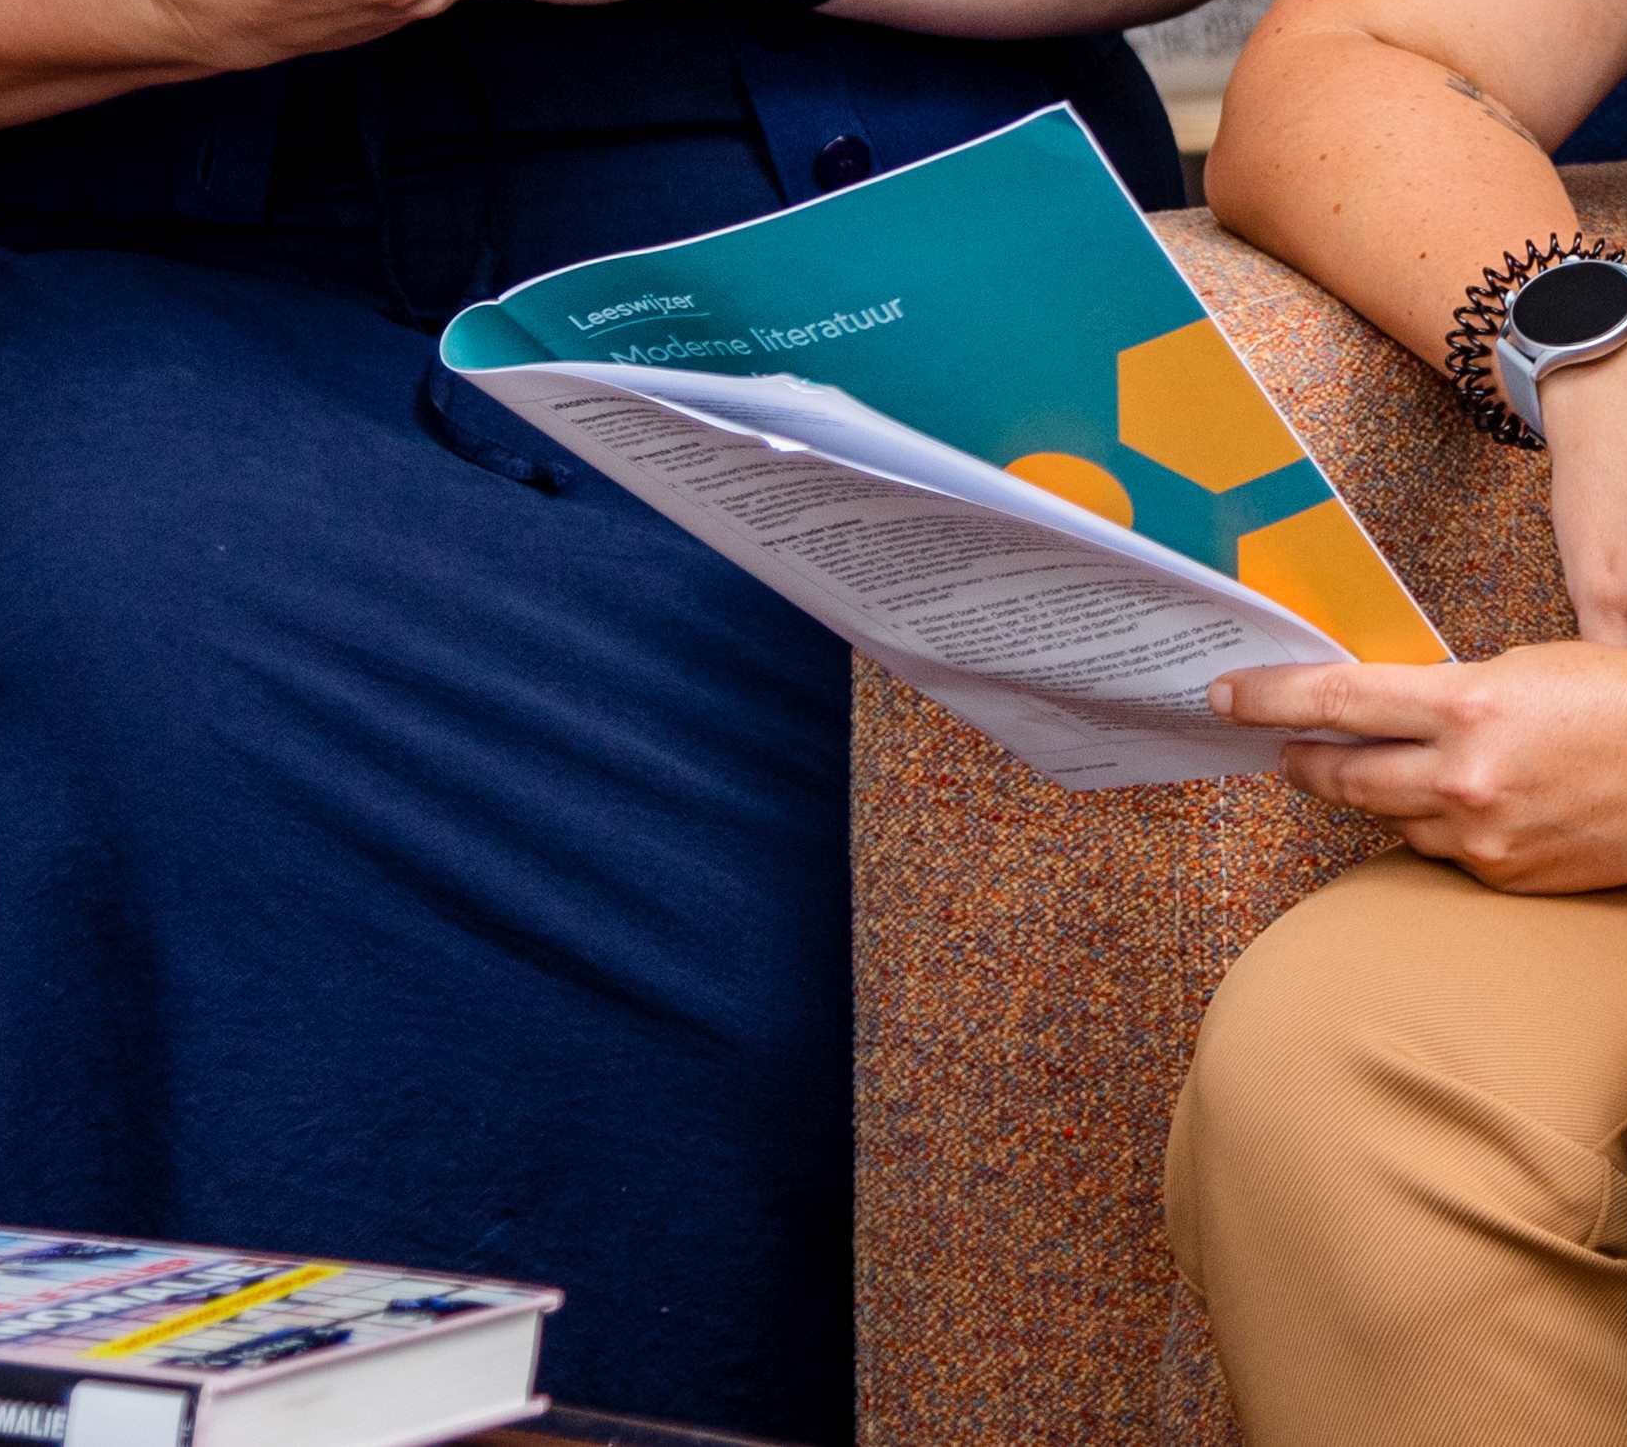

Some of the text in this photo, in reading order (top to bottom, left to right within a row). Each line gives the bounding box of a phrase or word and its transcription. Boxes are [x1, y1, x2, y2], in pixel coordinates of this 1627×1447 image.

[568, 293, 697, 332] Leeswijzer
[609, 296, 905, 366] Moderne literatuur
